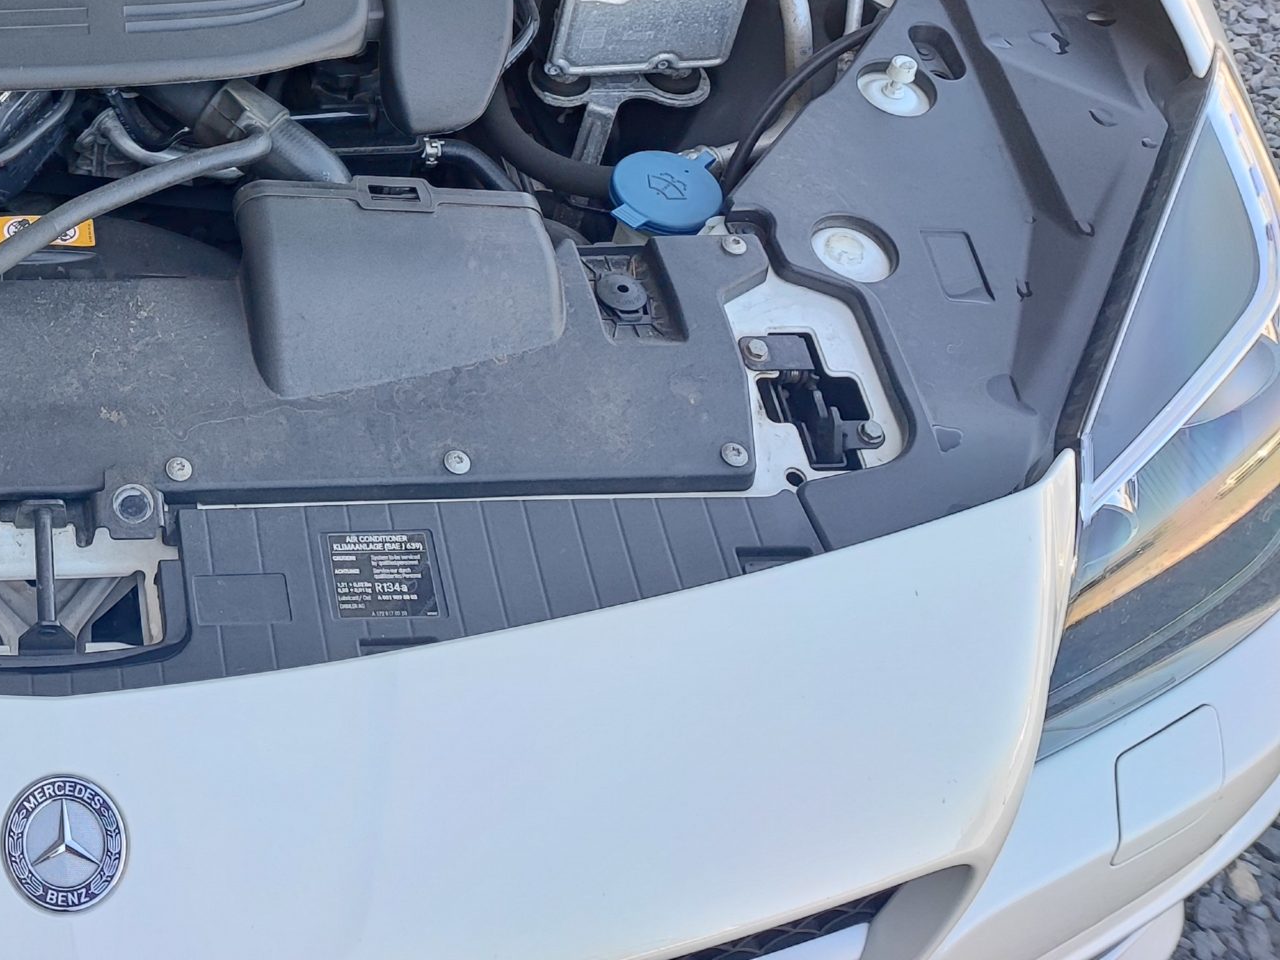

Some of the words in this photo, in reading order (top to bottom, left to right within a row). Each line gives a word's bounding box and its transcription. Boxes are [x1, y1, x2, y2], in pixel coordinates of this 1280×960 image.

[360, 535, 408, 543] CONDITIONER
[333, 543, 383, 551] KLIMAANLAGE
[23, 782, 104, 812] MERCEDES
[46, 889, 90, 906] BENZ
